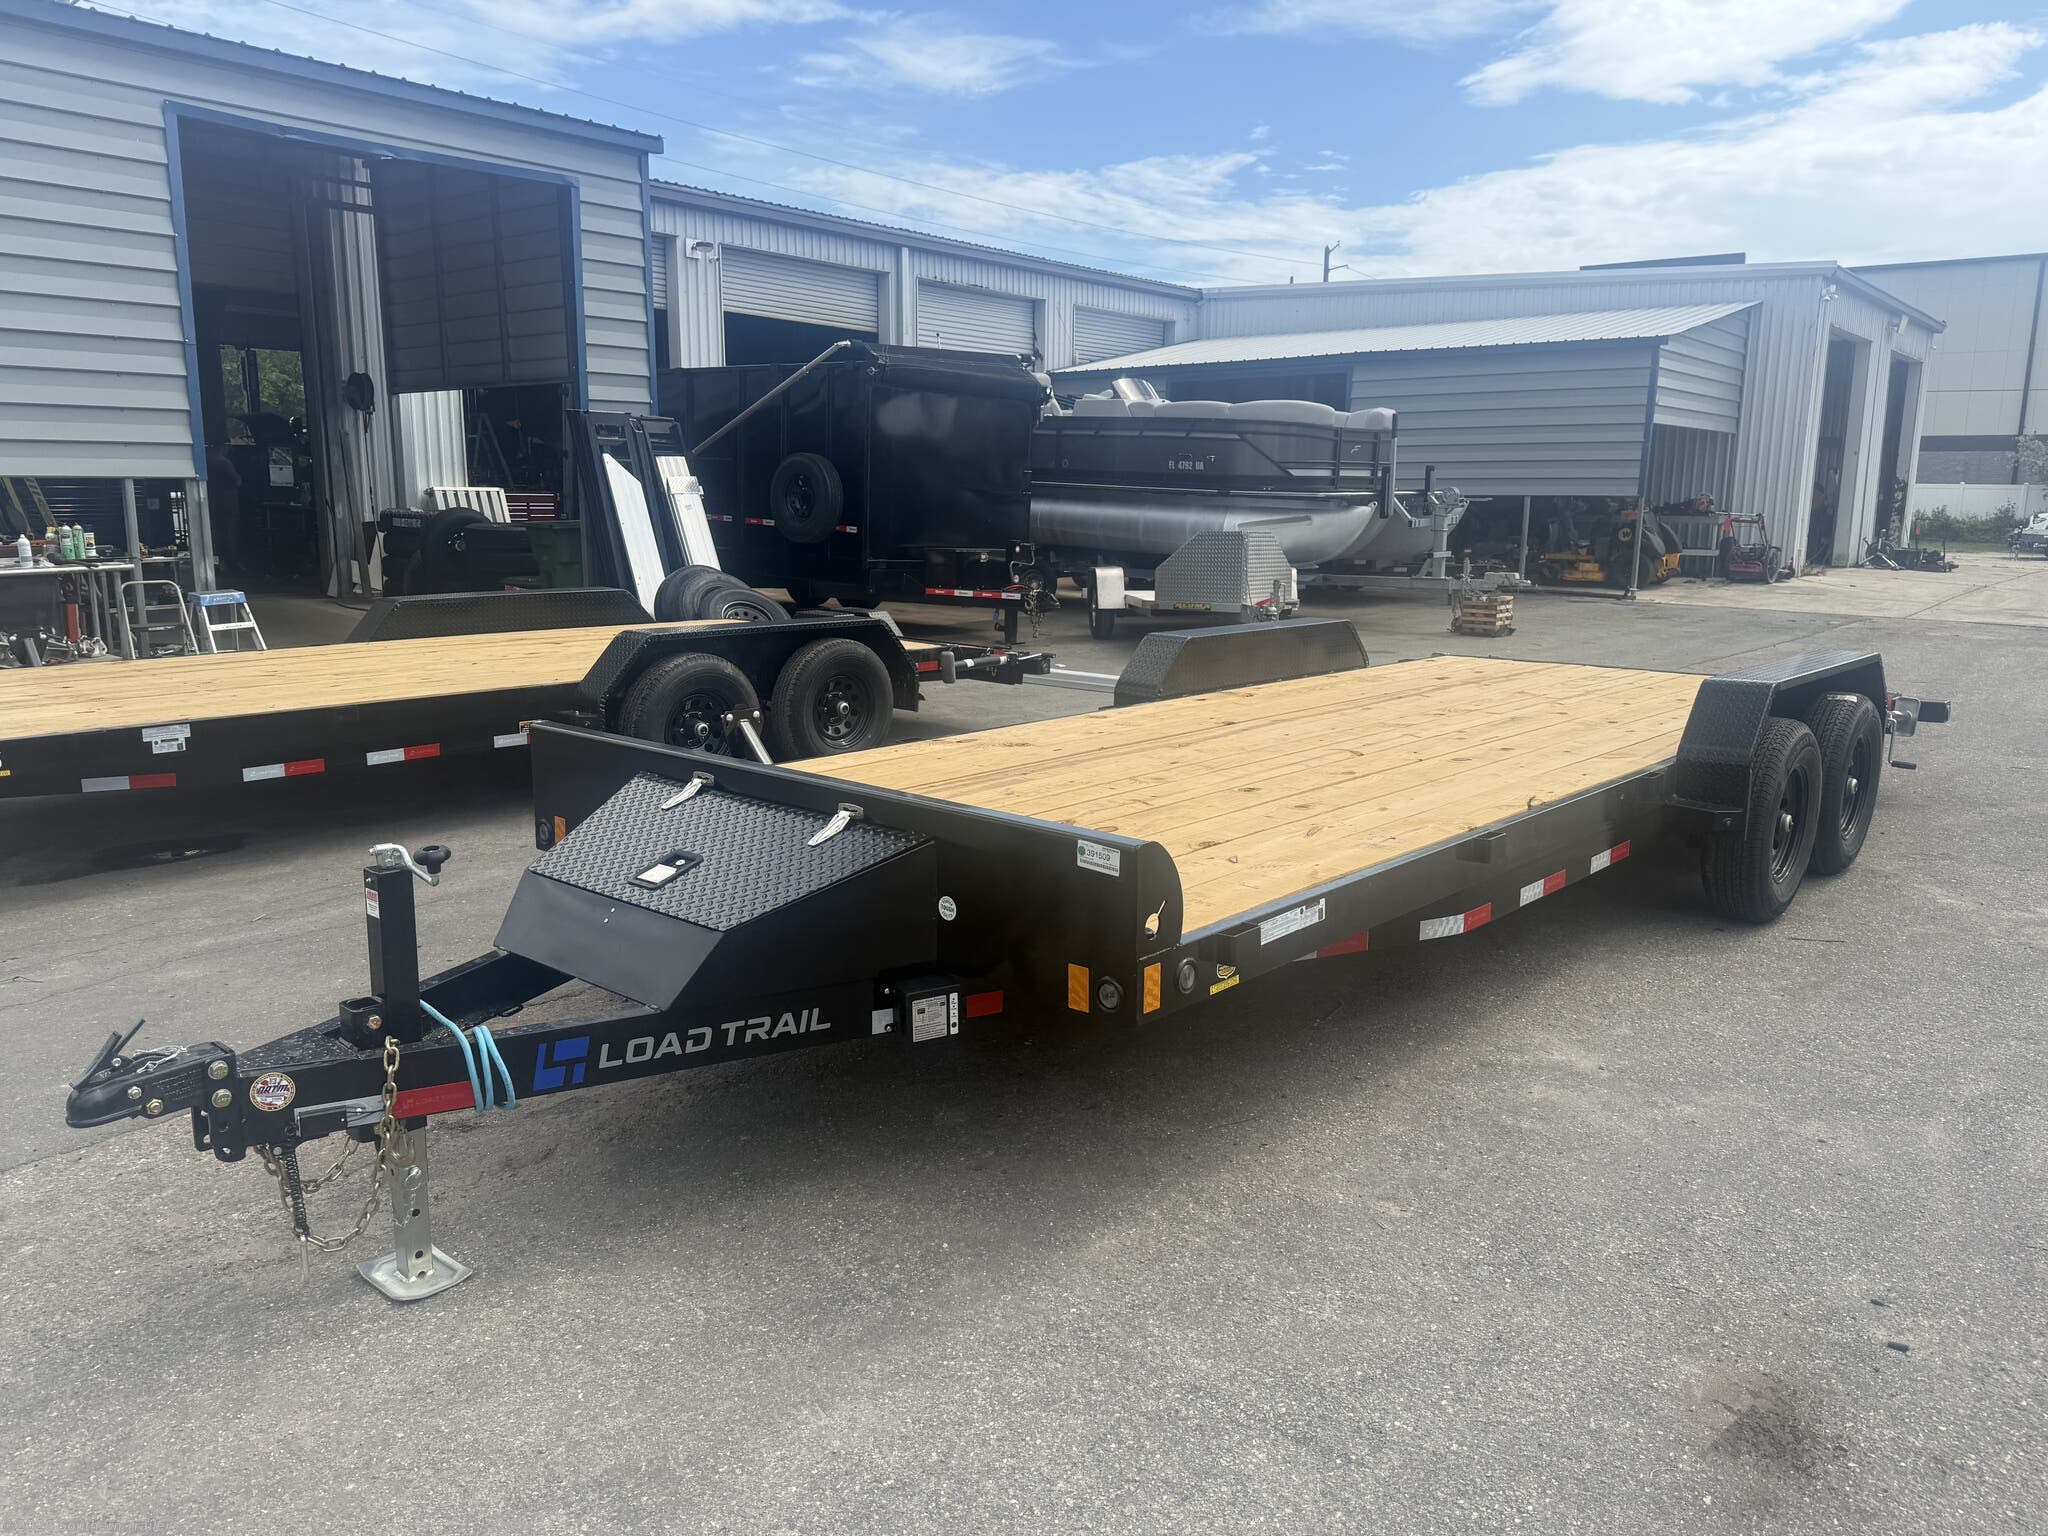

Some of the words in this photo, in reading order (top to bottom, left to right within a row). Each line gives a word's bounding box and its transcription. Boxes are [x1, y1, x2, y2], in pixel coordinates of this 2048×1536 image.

[1169, 461, 1175, 470] FL
[598, 1026, 713, 1069] LOAD
[720, 1007, 832, 1047] TRAIL
